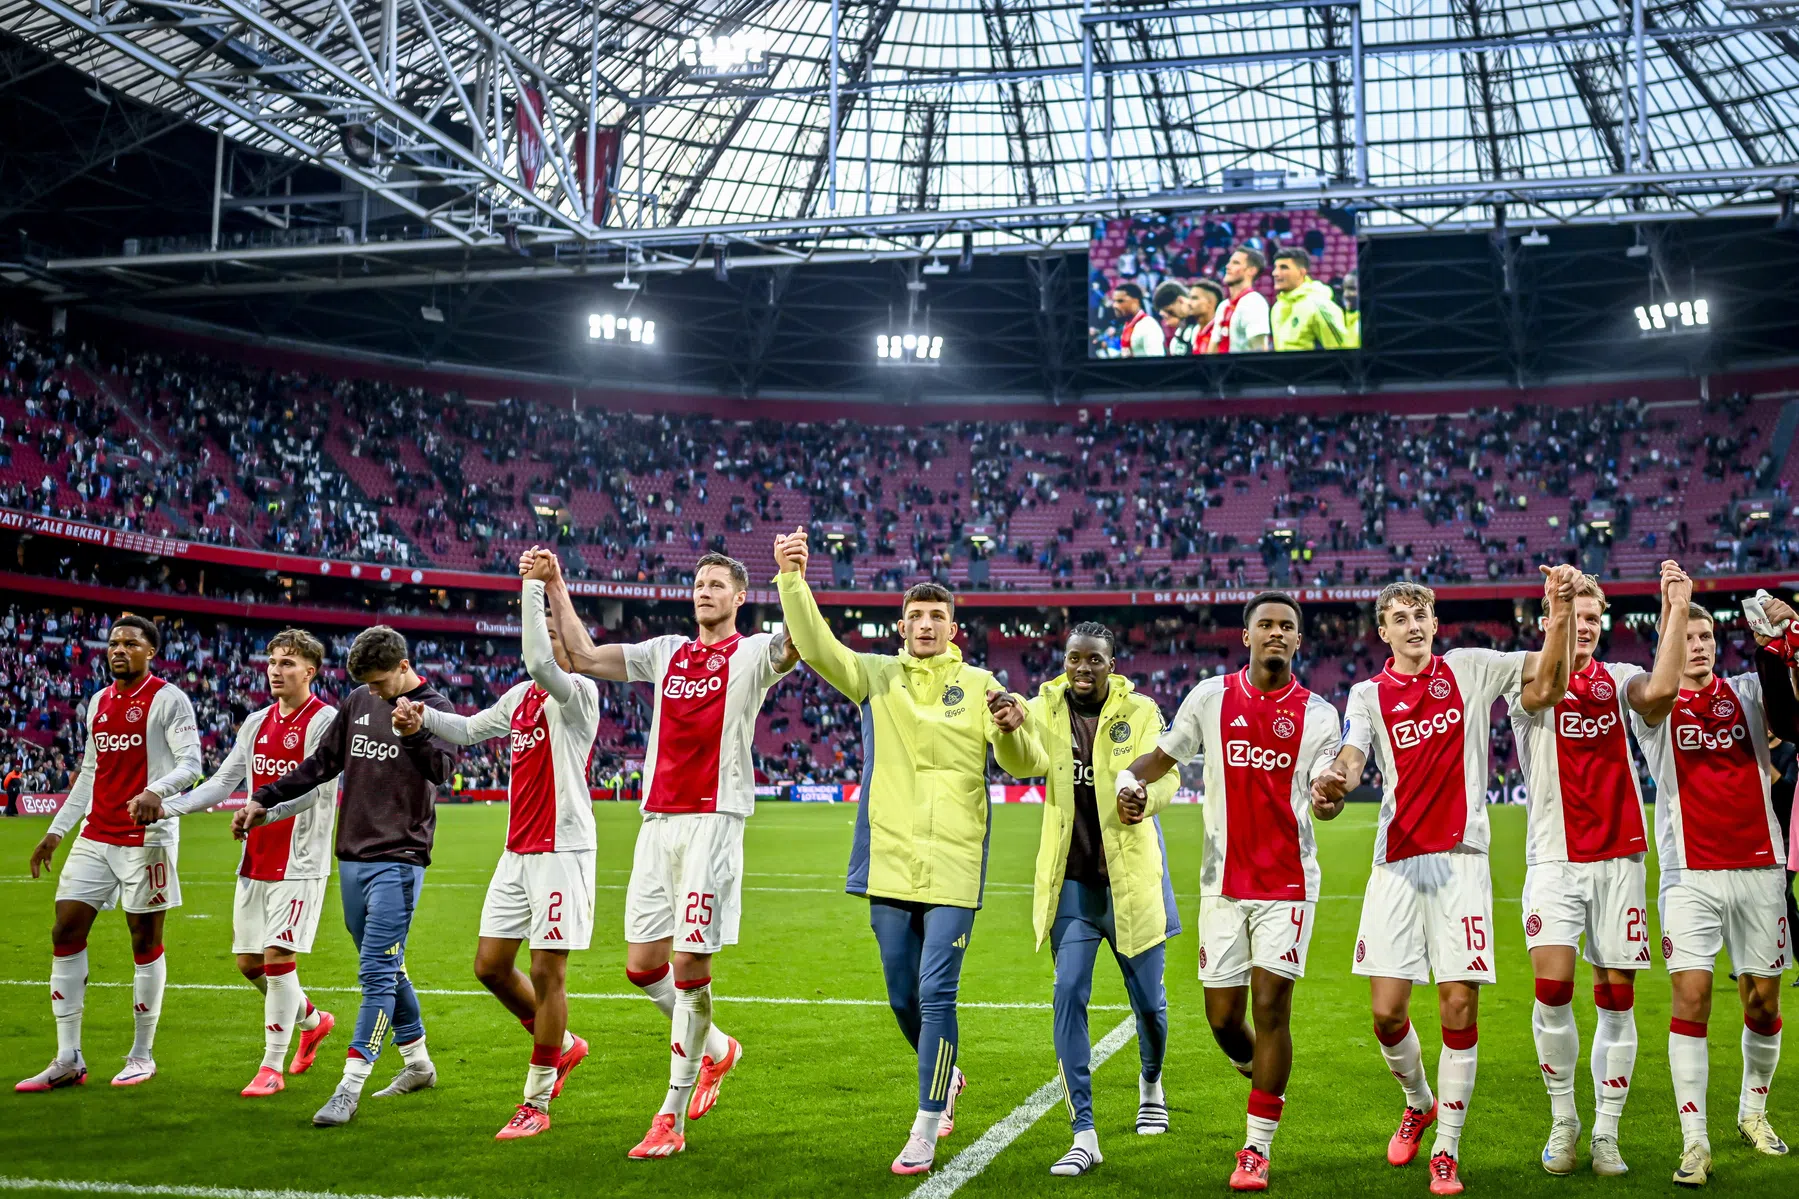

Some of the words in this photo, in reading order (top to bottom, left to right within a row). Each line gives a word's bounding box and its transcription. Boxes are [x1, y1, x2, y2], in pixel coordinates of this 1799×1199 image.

[65, 524, 101, 541] BEKER
[566, 582, 656, 597] NEDERLANDSE
[1154, 591, 1171, 602] DE
[1175, 592, 1210, 602] AJAX
[1306, 590, 1322, 600] DE
[663, 675, 722, 699] Ziggo
[94, 732, 143, 752] Ziggo
[1391, 708, 1461, 749] Ziggo
[1676, 724, 1746, 750] Ziggo
[350, 734, 400, 761] Ziggo
[1226, 740, 1292, 771] Ziggo
[22, 795, 57, 813] Ziggo
[145, 862, 167, 891] 10
[290, 898, 304, 927] 11
[548, 891, 563, 922] 2
[685, 891, 715, 926] 25
[1291, 906, 1305, 944] 4
[1460, 916, 1487, 951] 15
[1777, 916, 1787, 949] 3
